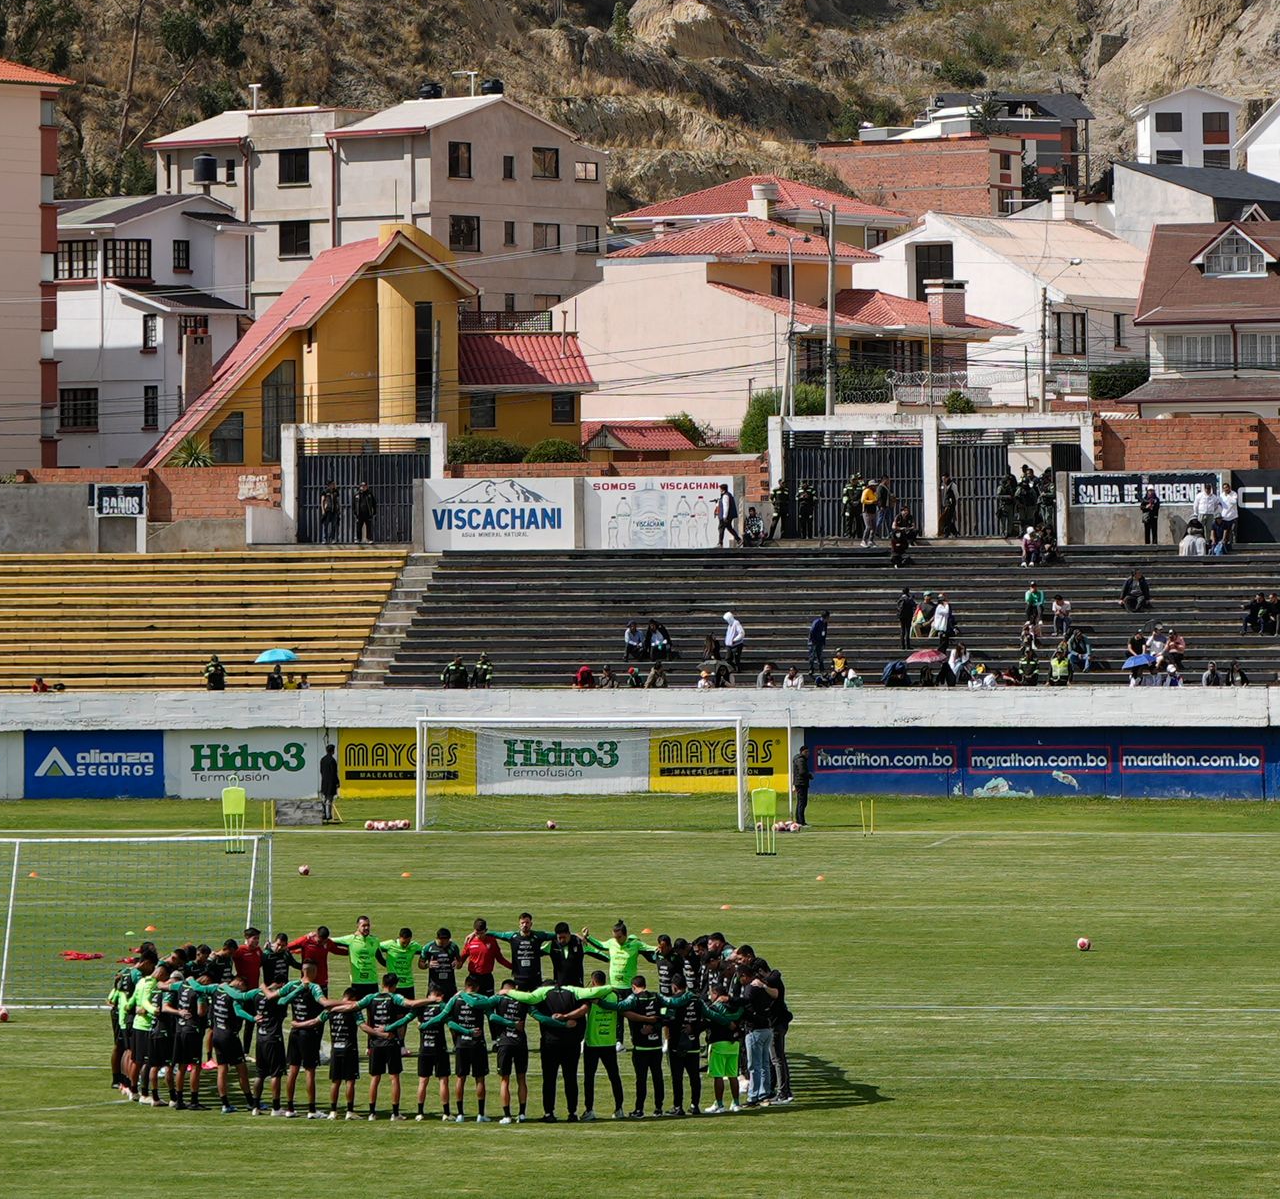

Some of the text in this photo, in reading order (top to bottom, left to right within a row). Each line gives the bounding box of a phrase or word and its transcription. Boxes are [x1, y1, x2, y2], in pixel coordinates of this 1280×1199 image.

[592, 482, 719, 491] SOMOS VISCACHANI
[1078, 484, 1120, 503] SALIDA
[1124, 484, 1139, 502] DE
[102, 495, 140, 515] BAÑOS
[432, 507, 562, 530] VISCACHANI
[76, 749, 154, 764] alianza
[190, 742, 306, 772] Hidro3
[503, 739, 619, 768] Hidro3
[817, 751, 953, 767] marathon.com.bo
[971, 752, 1108, 768] marathon.com.bo
[1122, 752, 1260, 767] marathon.com.bo
[76, 765, 154, 776] SEGUROS
[505, 768, 583, 778] Termofusión
